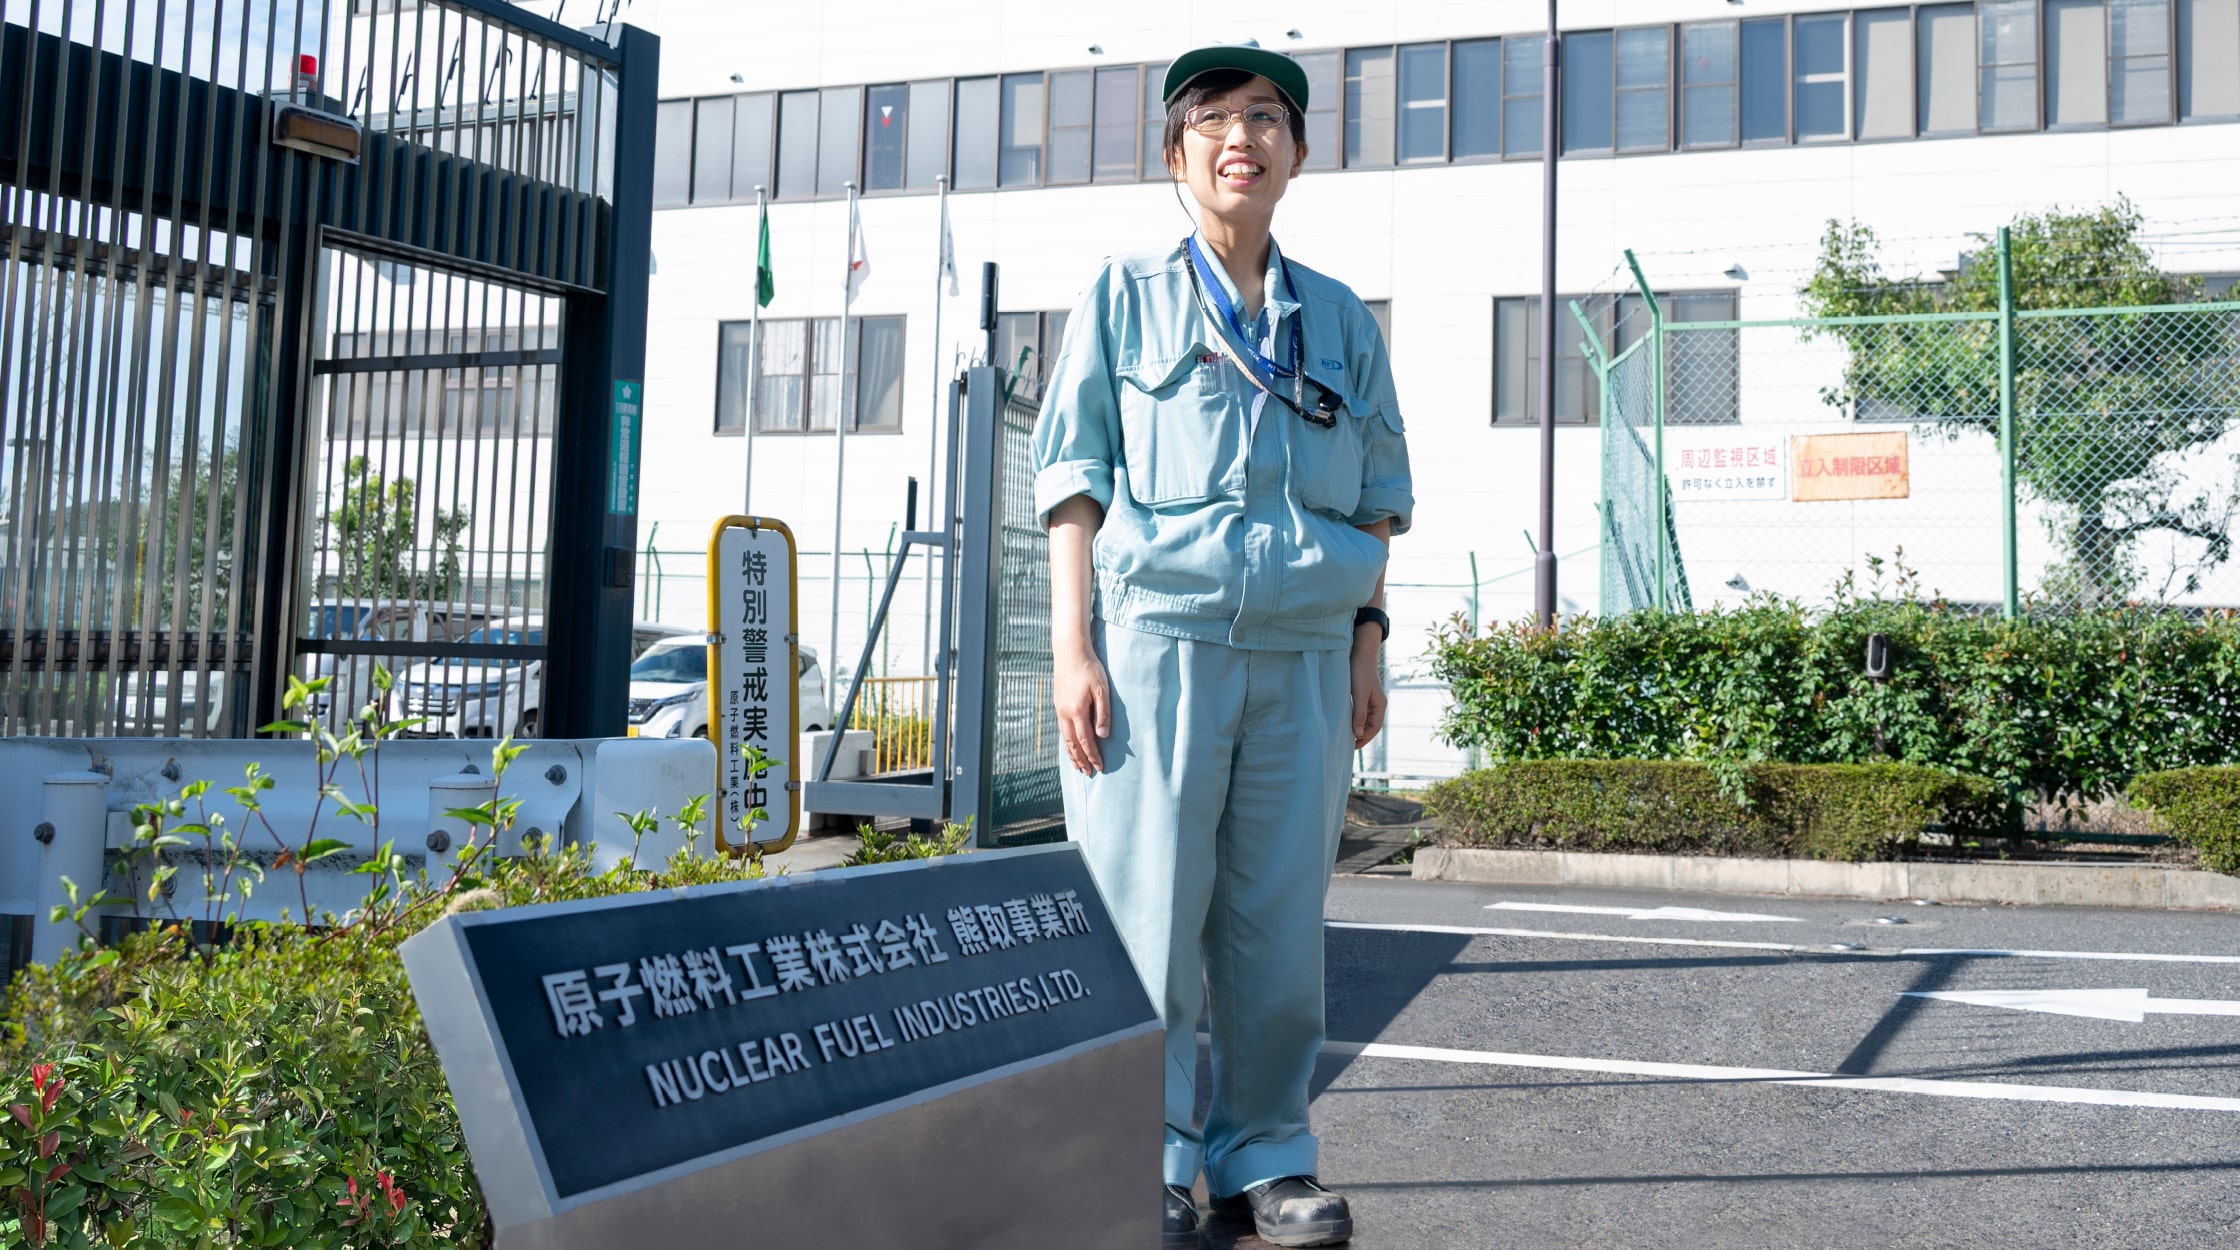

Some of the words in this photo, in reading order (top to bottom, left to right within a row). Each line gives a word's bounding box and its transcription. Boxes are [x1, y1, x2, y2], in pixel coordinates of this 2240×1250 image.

[1681, 447, 1777, 469] 周辺監視区域
[1798, 456, 1902, 478] 立入制限区域
[1682, 477, 1775, 490] 許可なく立入を禁ず
[541, 913, 949, 1039] 原子燃料工業株式会社
[946, 888, 1093, 956] 熊取事業所
[645, 1032, 812, 1108] NUCLEAR
[812, 1013, 896, 1063] FUEL
[893, 968, 1091, 1042] INDUSTRIES,LTD.
